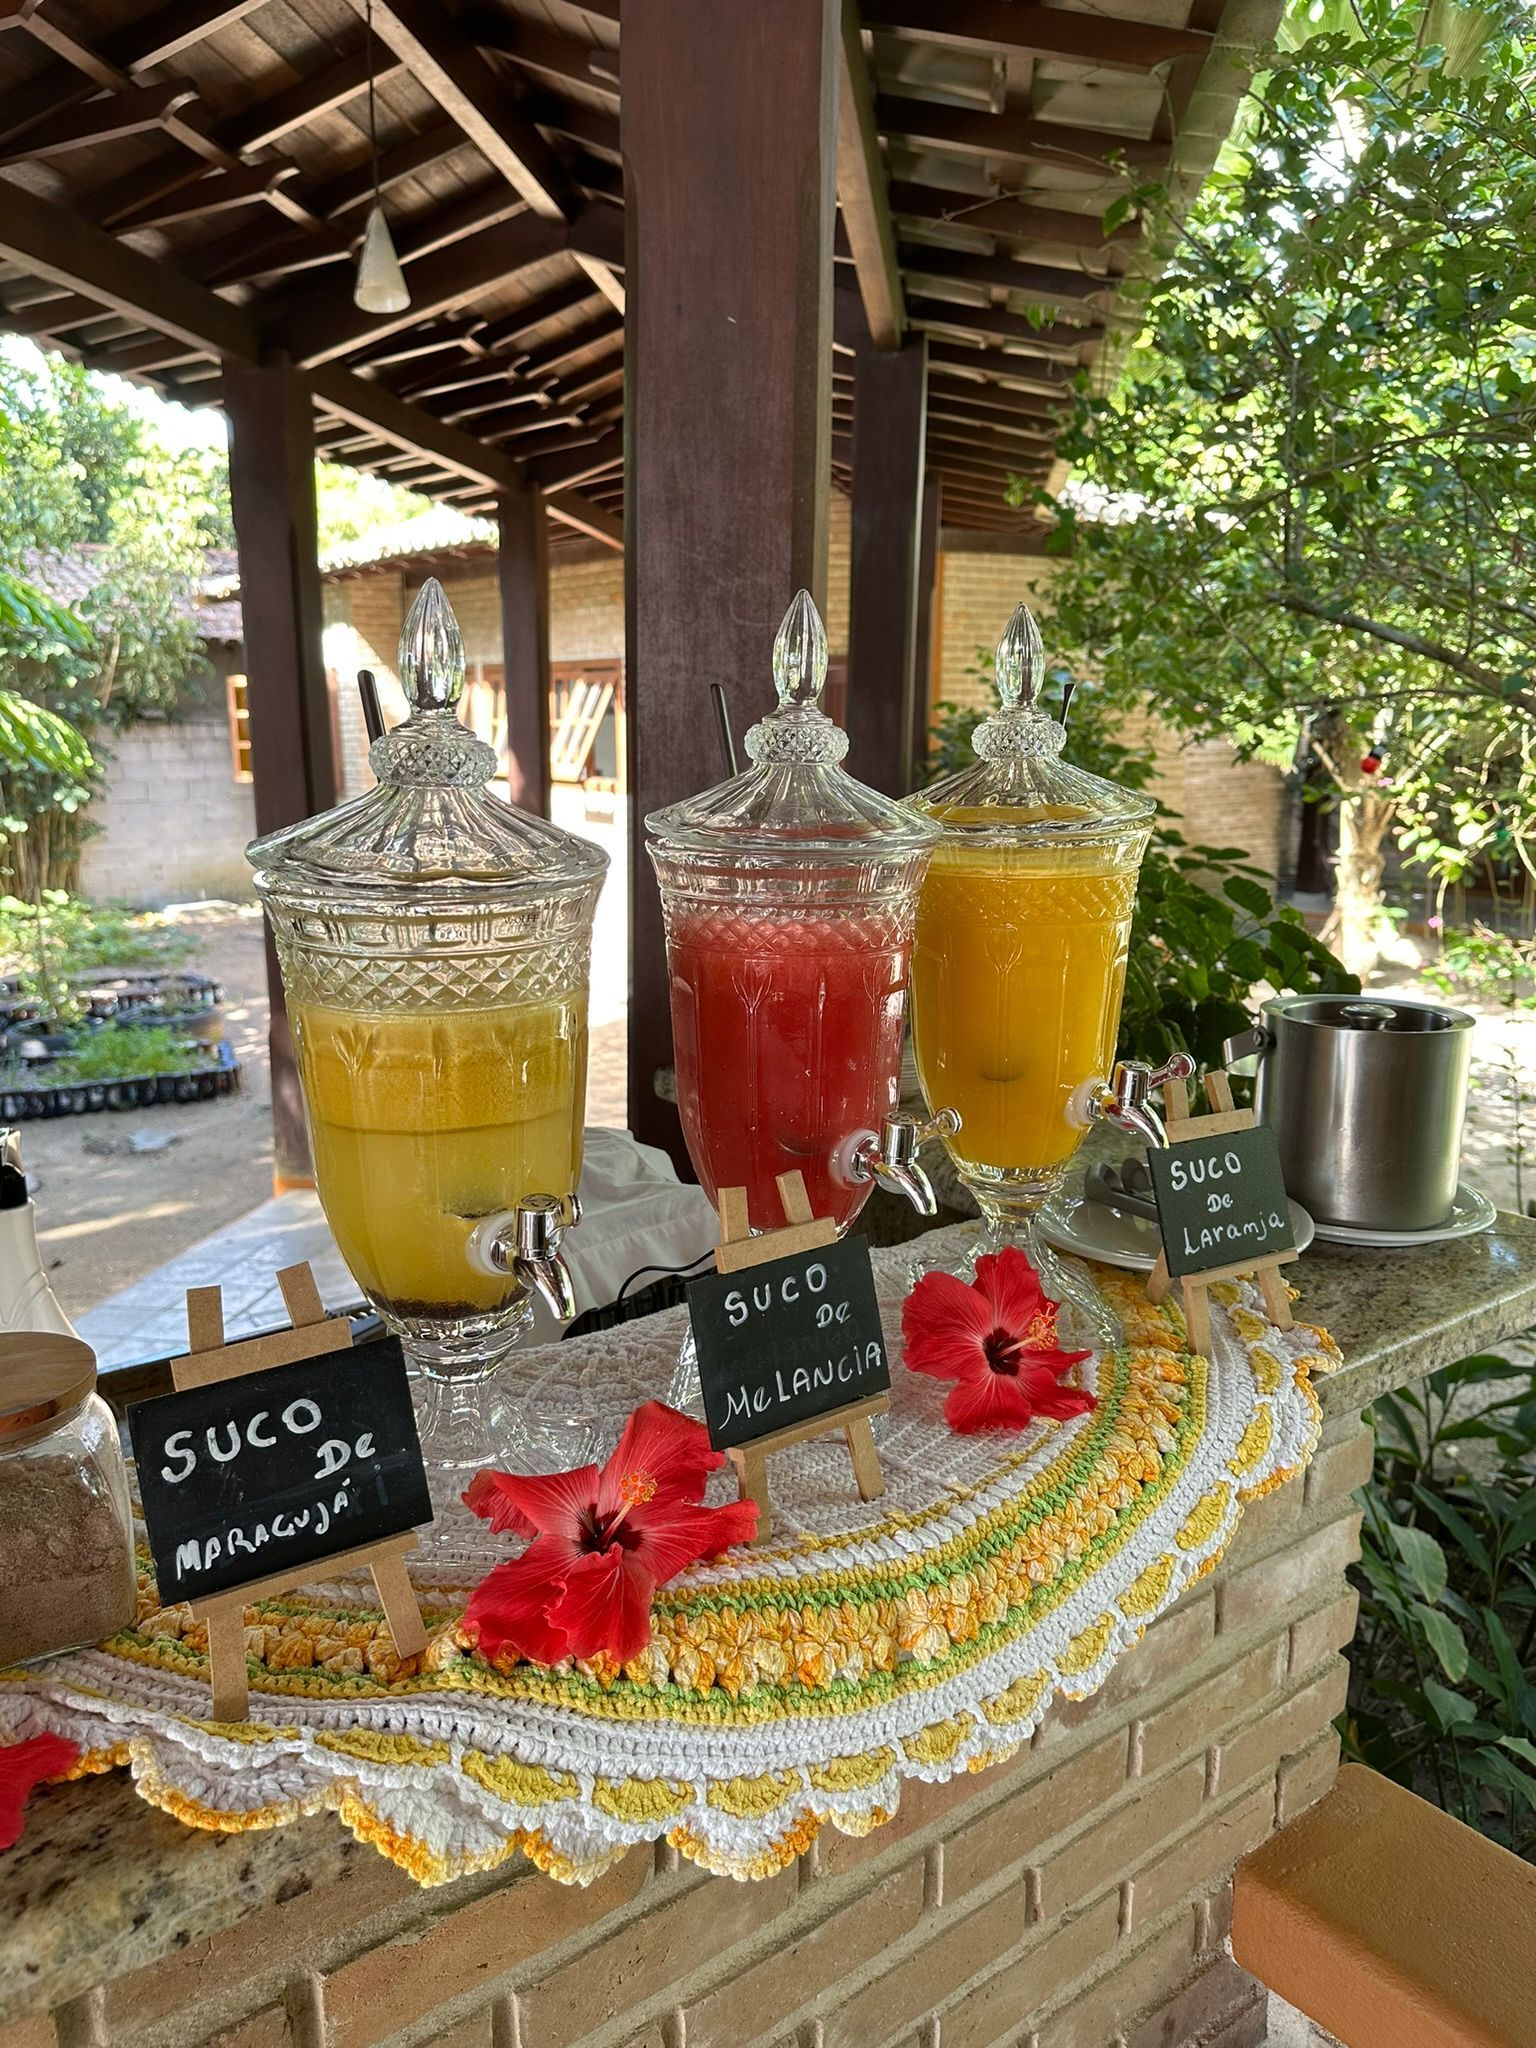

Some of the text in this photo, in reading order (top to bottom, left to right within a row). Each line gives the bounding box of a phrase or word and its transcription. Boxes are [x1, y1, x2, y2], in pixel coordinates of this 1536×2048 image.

[1171, 1152, 1241, 1190] SUCO
[724, 1263, 827, 1326] SUCO
[161, 1398, 322, 1483] SUCO
